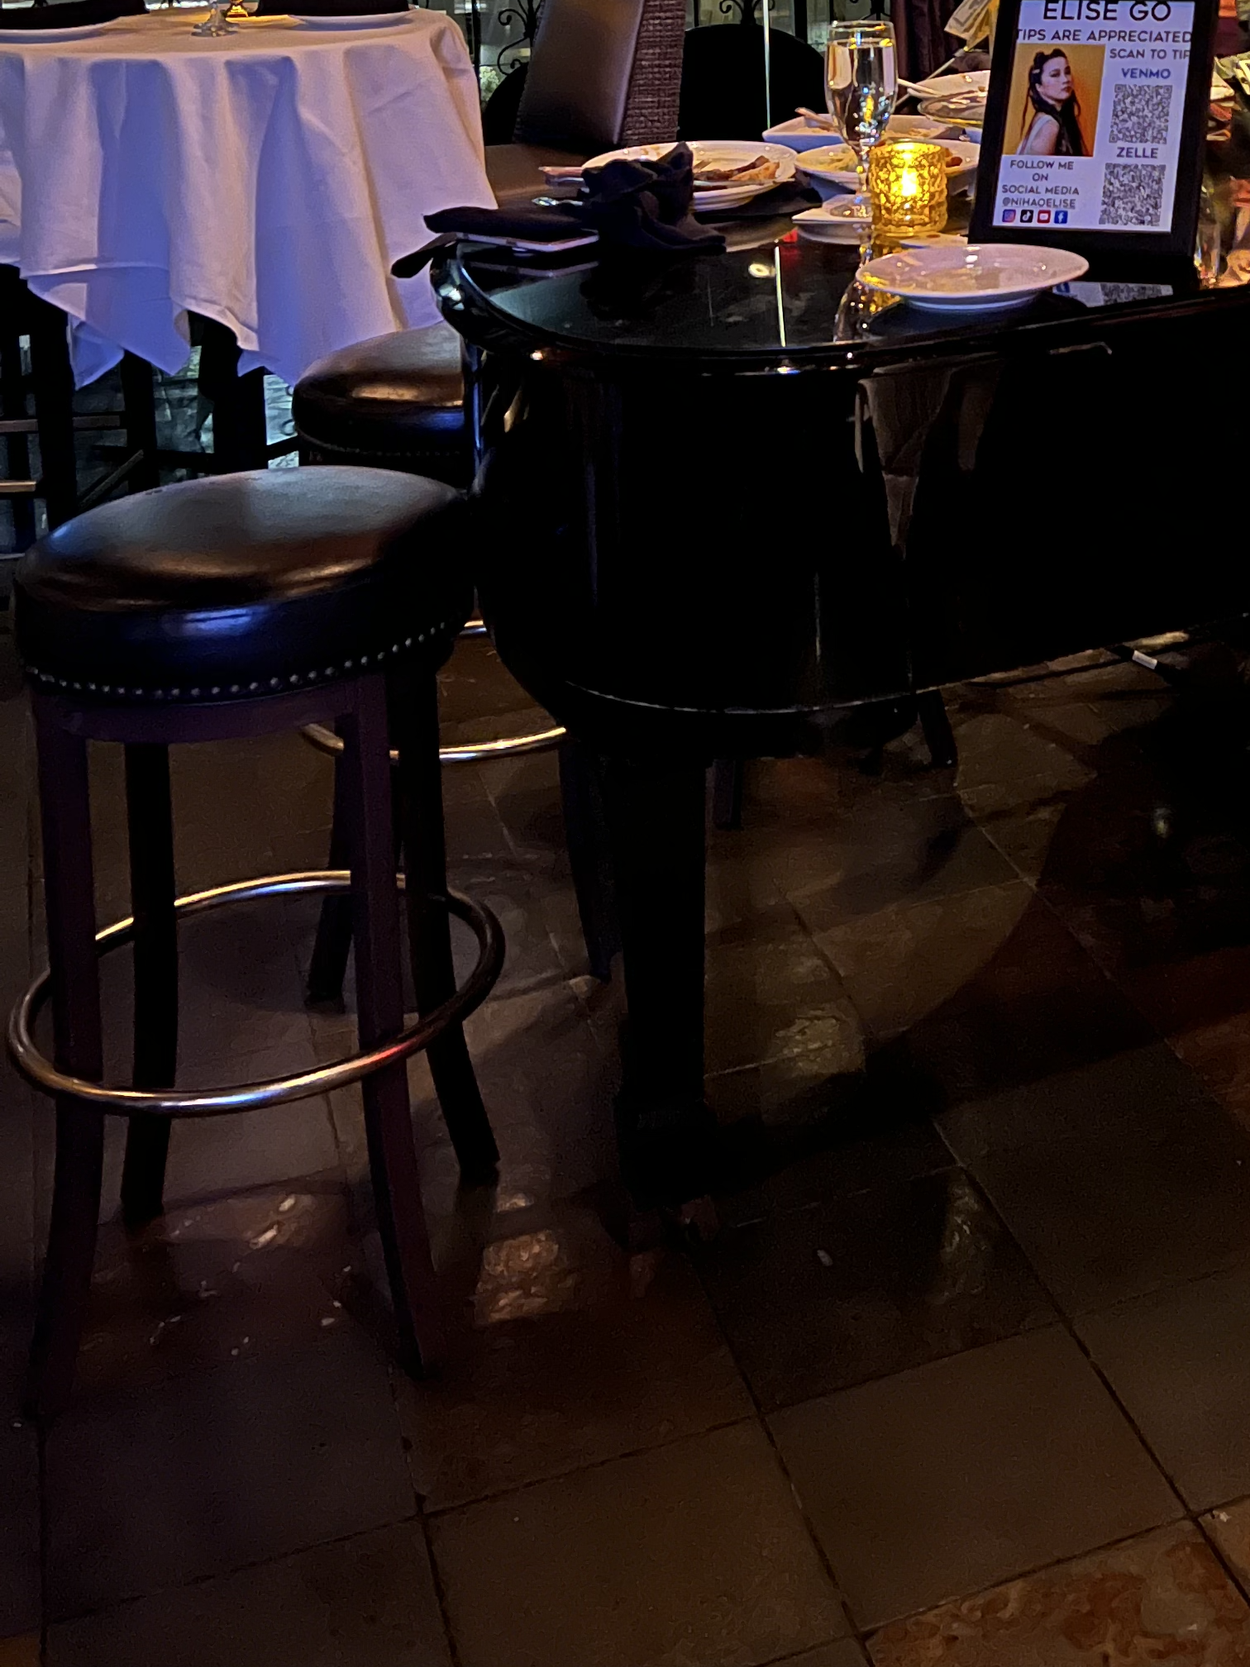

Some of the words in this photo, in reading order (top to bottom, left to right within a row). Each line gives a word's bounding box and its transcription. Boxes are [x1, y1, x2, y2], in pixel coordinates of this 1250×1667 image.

[1043, 0, 1118, 21] ELISE
[1129, 0, 1171, 22] GO
[1017, 28, 1046, 41] TIPS
[1050, 29, 1082, 41] ARE
[1086, 30, 1192, 43] APPRECIATED
[1109, 48, 1146, 59] SCAN
[1150, 49, 1167, 60] TO
[1121, 67, 1171, 79] VENMO
[1116, 146, 1159, 159] ZELLE
[1009, 159, 1055, 169] FOLLOW
[1057, 161, 1074, 170] ME
[1032, 172, 1049, 182] ON
[1001, 184, 1041, 194] SOCIAL
[1045, 186, 1080, 195] MEDIA
[1002, 197, 1077, 209] @NIHAOELISE
